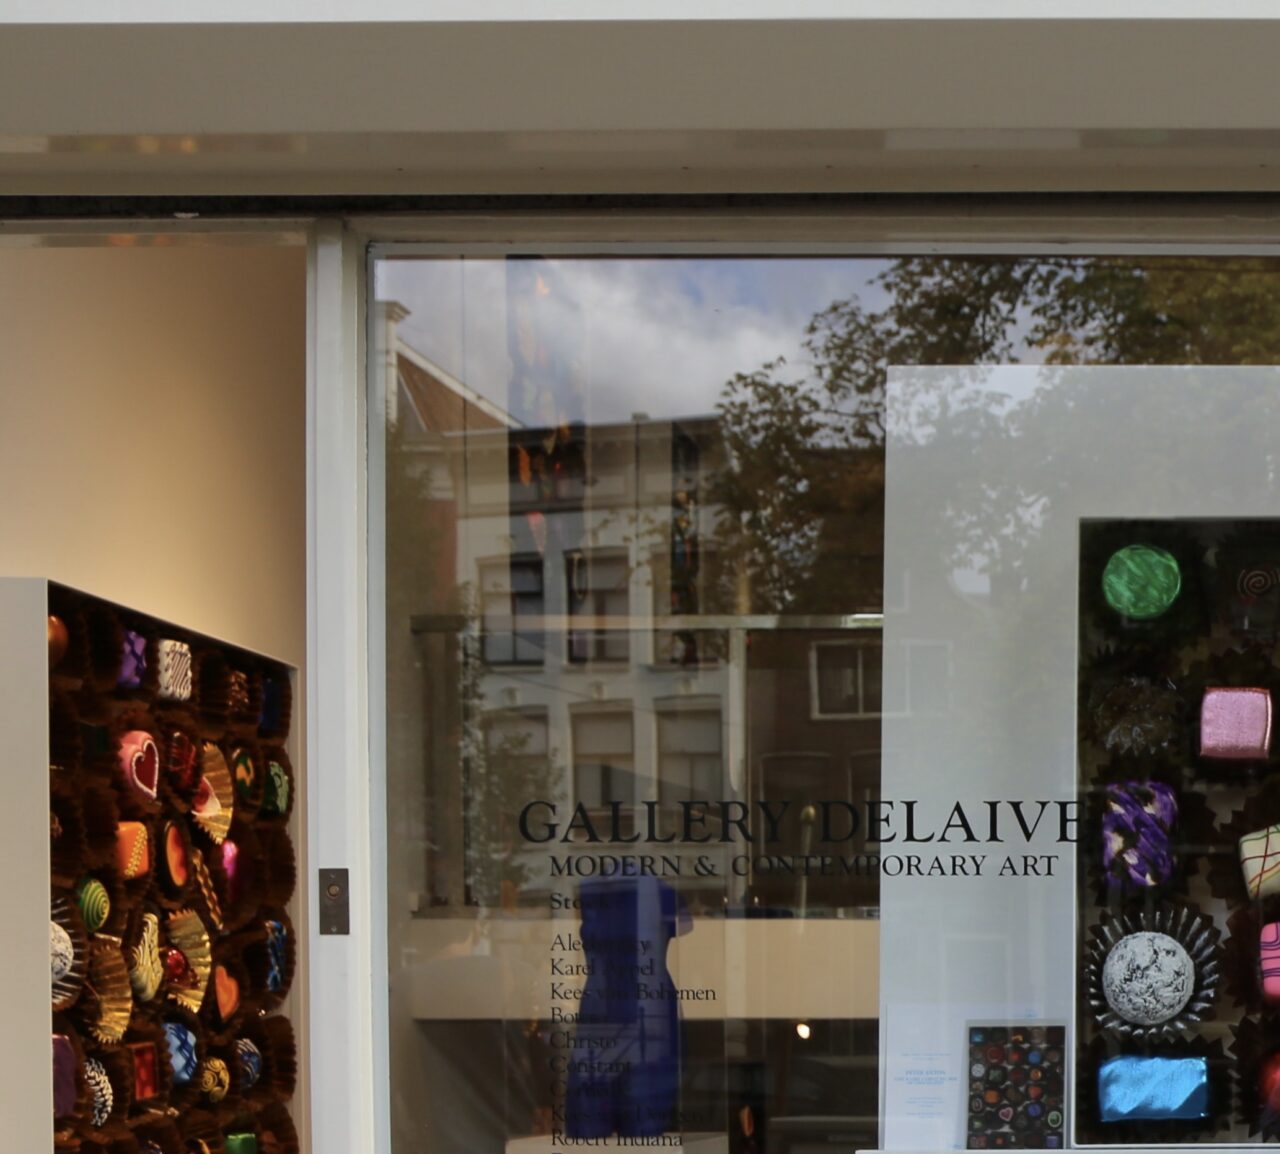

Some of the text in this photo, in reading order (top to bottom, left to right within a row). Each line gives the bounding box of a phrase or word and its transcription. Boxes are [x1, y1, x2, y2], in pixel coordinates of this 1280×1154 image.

[519, 800, 1087, 843] GALLERY DELAIVE
[550, 855, 1060, 877] MODERN & CONTEMPORARY ART
[550, 957, 596, 976] Karel
[550, 982, 590, 1000] Kees
[637, 981, 717, 1000] Bohemen
[550, 1031, 617, 1049] Christo
[550, 1056, 631, 1073] Constant
[551, 1128, 683, 1146] Robert Indiana
